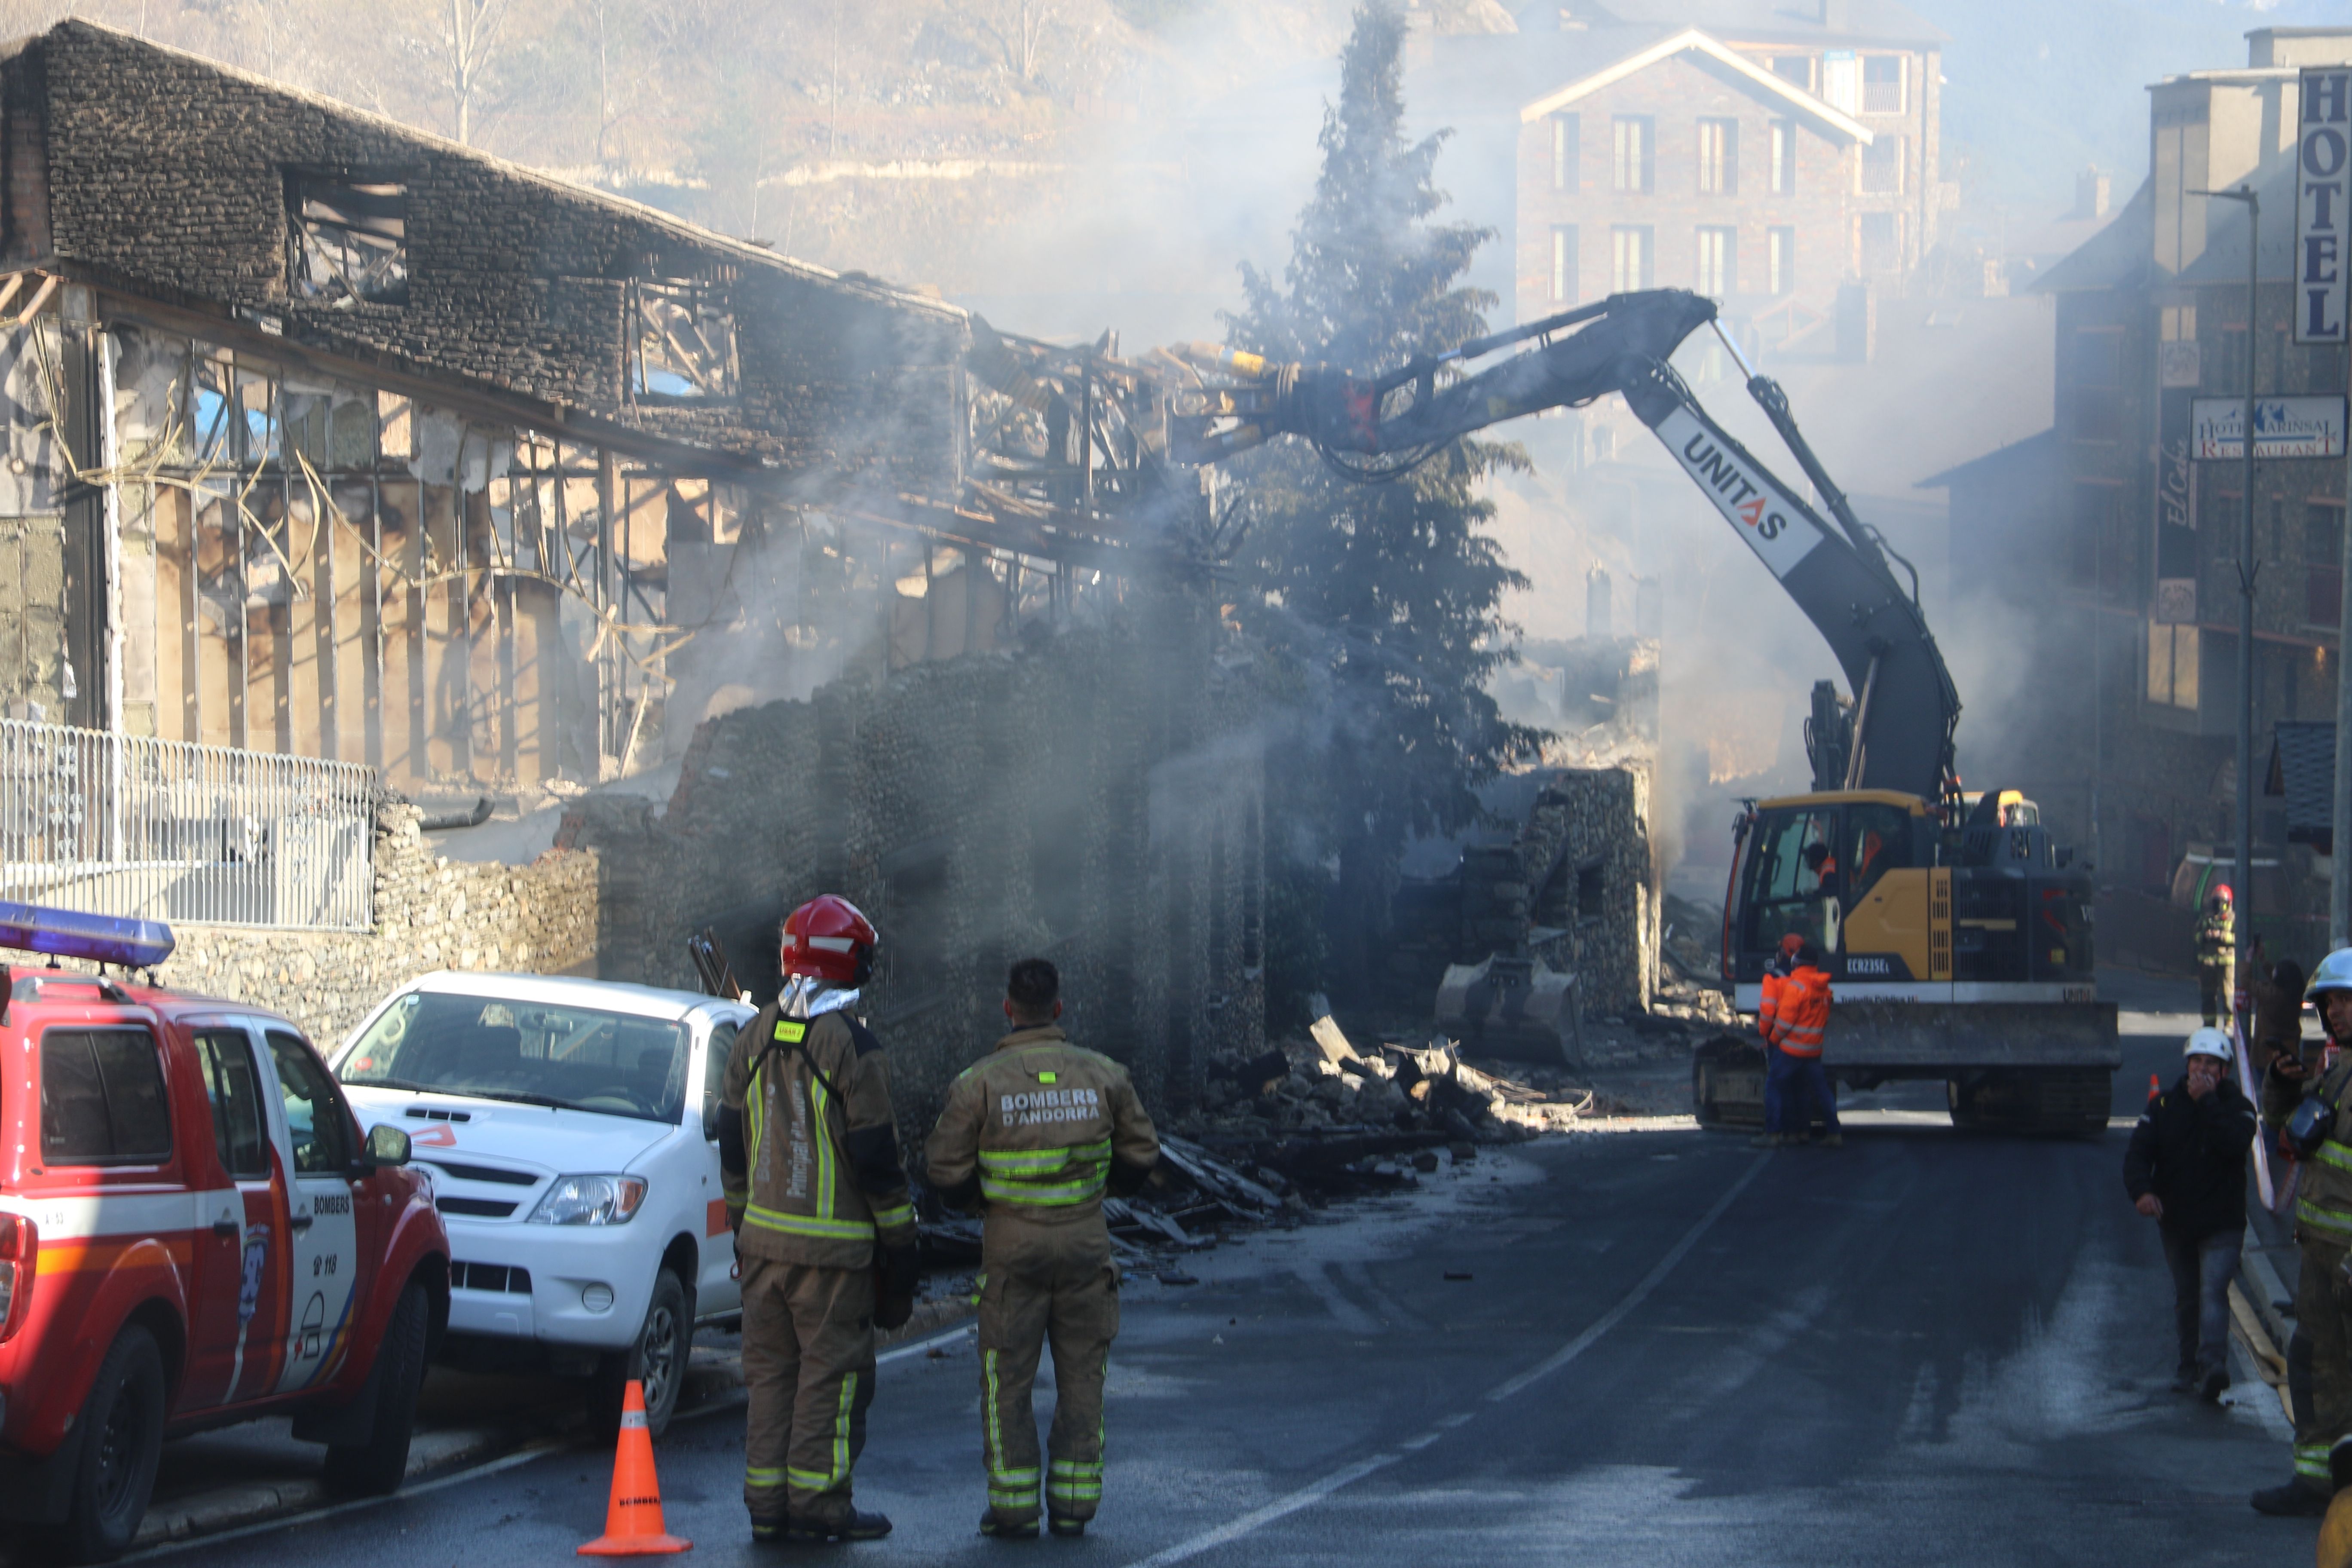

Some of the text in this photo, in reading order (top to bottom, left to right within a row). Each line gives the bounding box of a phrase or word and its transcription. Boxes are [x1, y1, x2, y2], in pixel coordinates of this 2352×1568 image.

[2302, 74, 2349, 336] HOTEL
[2202, 436, 2336, 456] RESAURANT
[1684, 432, 1786, 540] UNITAS
[1001, 1088, 1098, 1112] BOMBERS
[1002, 1105, 1099, 1127] D'ANDORRA
[314, 1194, 349, 1214] BOMBERS
[325, 1254, 337, 1275] 118
